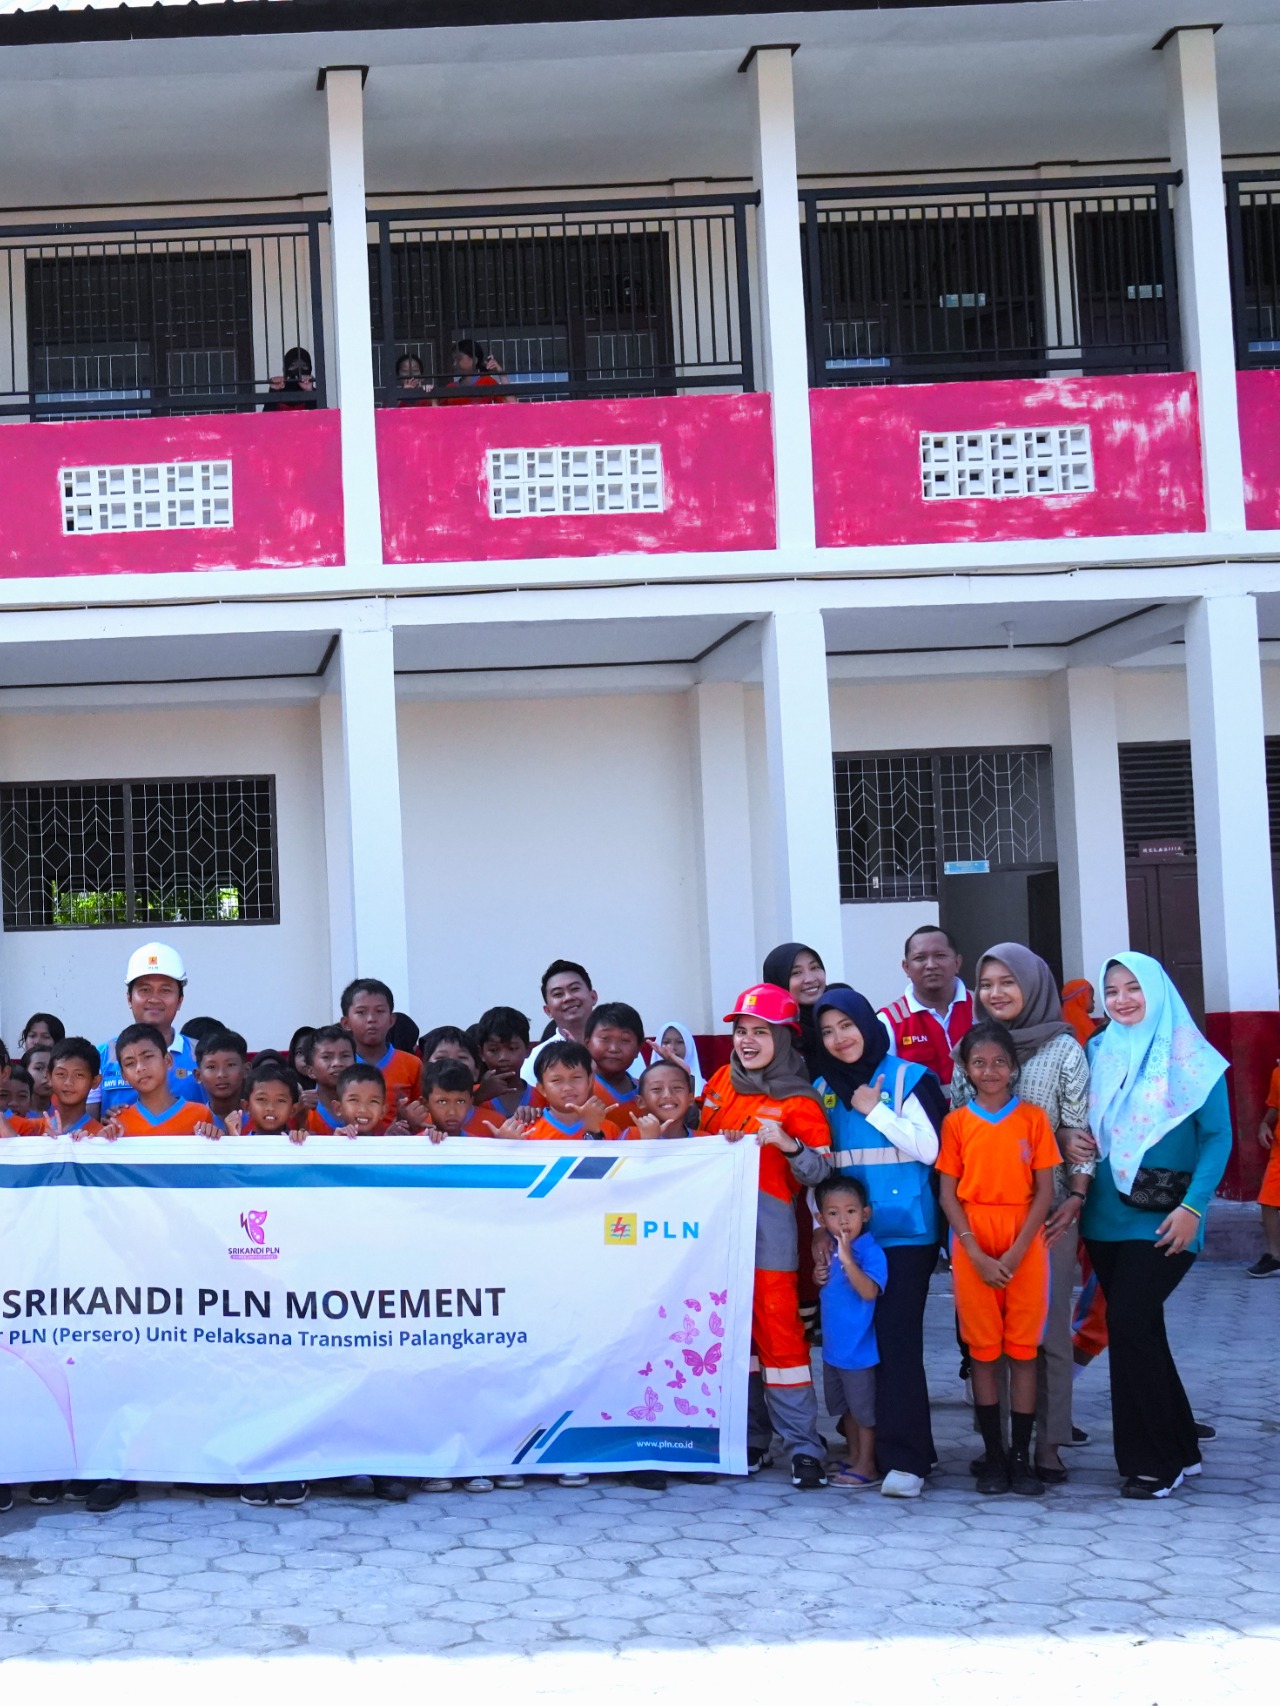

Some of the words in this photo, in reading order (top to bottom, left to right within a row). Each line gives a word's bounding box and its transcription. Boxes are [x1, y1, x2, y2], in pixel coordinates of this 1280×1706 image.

[912, 1035, 928, 1043] PLN
[643, 1220, 699, 1239] PLN
[2, 1286, 183, 1318] SRIKANDI
[198, 1288, 271, 1318] PLN
[286, 1287, 506, 1319] MOVEMENT
[9, 1328, 47, 1344] PLN
[52, 1326, 141, 1345] (Persero)
[146, 1326, 188, 1343] Unit
[193, 1327, 292, 1346] Pelaksana
[298, 1330, 393, 1347] Transmisi
[399, 1328, 528, 1349] Palangkaraya
[636, 1440, 694, 1450] www.pln.co.id
